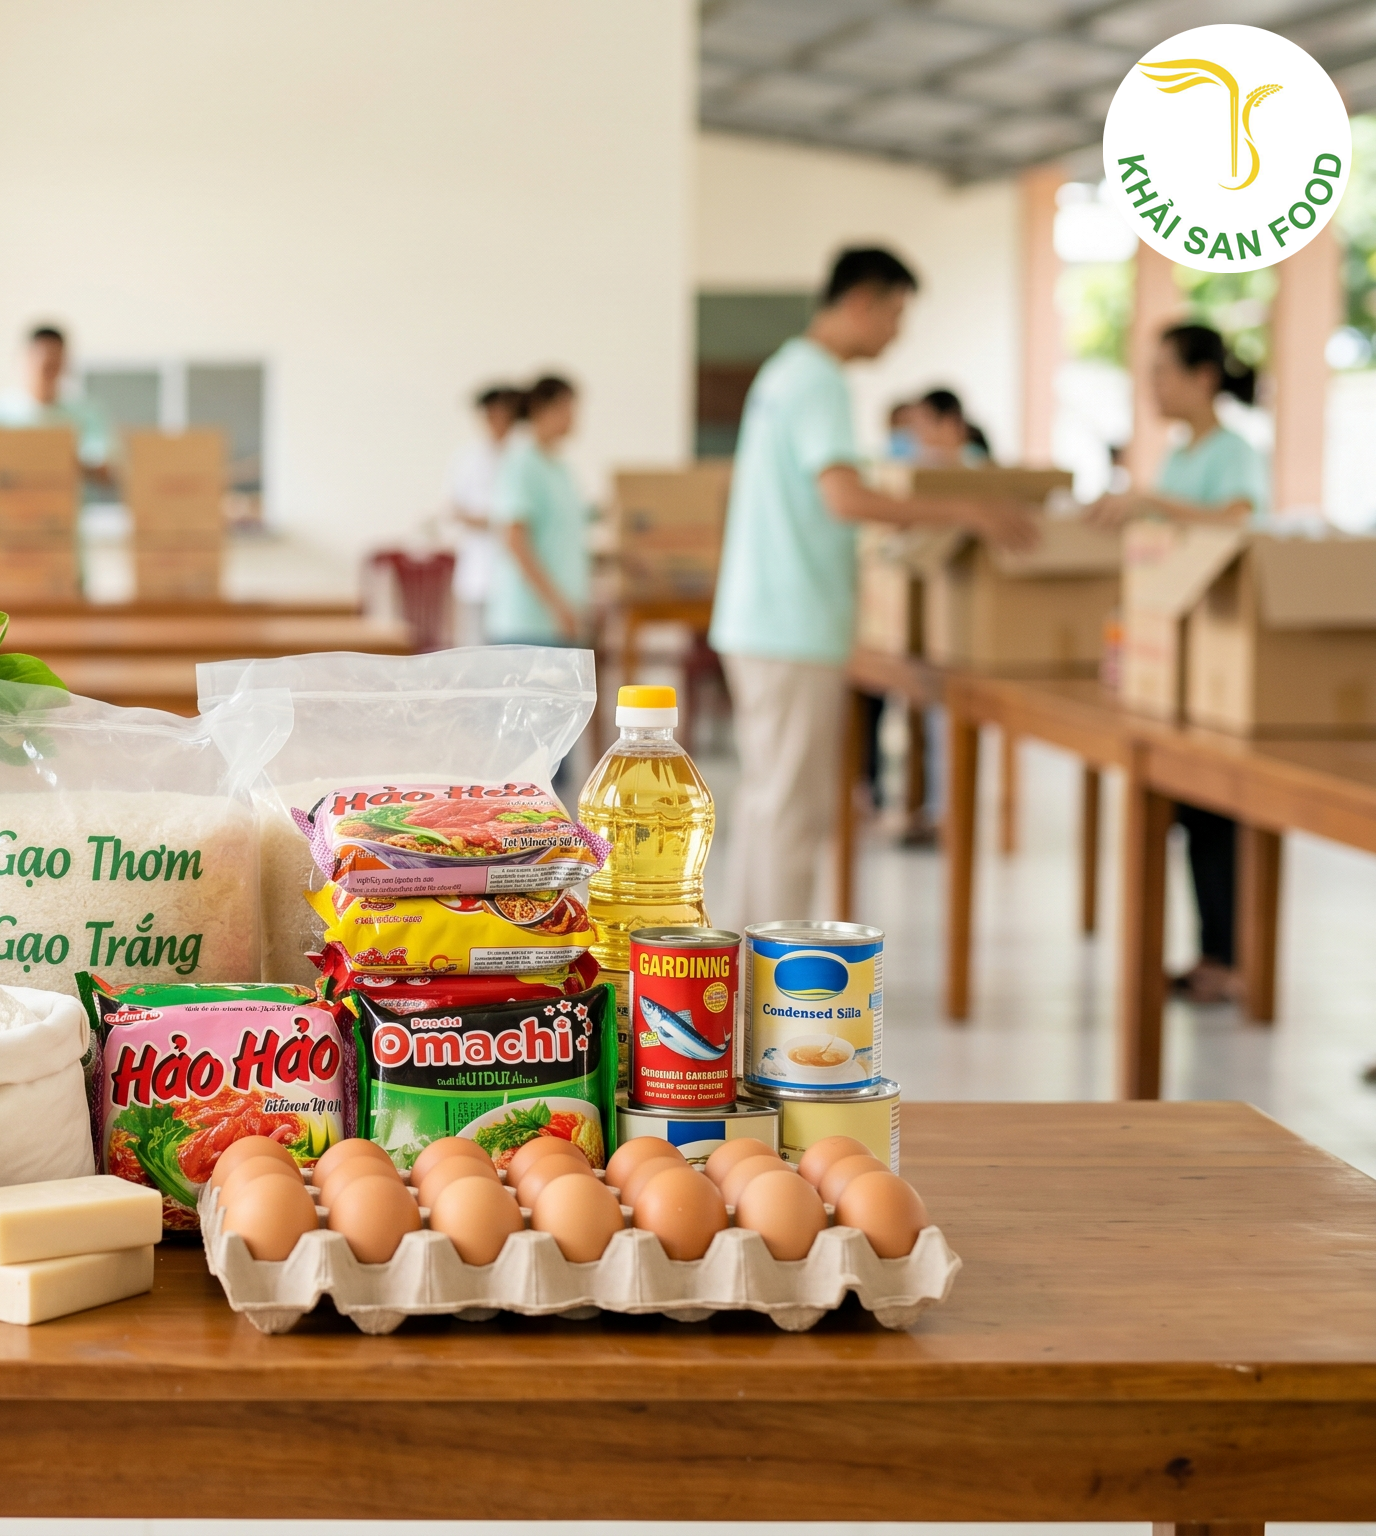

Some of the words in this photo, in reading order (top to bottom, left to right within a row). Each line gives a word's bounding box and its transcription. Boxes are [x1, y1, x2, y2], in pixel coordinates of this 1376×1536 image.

[86, 835, 203, 882] Thơm
[85, 912, 203, 975] Trắng
[639, 952, 730, 979] GARDINNG
[762, 1003, 833, 1019] Condensed
[111, 1033, 224, 1107] Hảo
[233, 1017, 341, 1091] Hảo
[373, 1016, 573, 1067] Omachi
